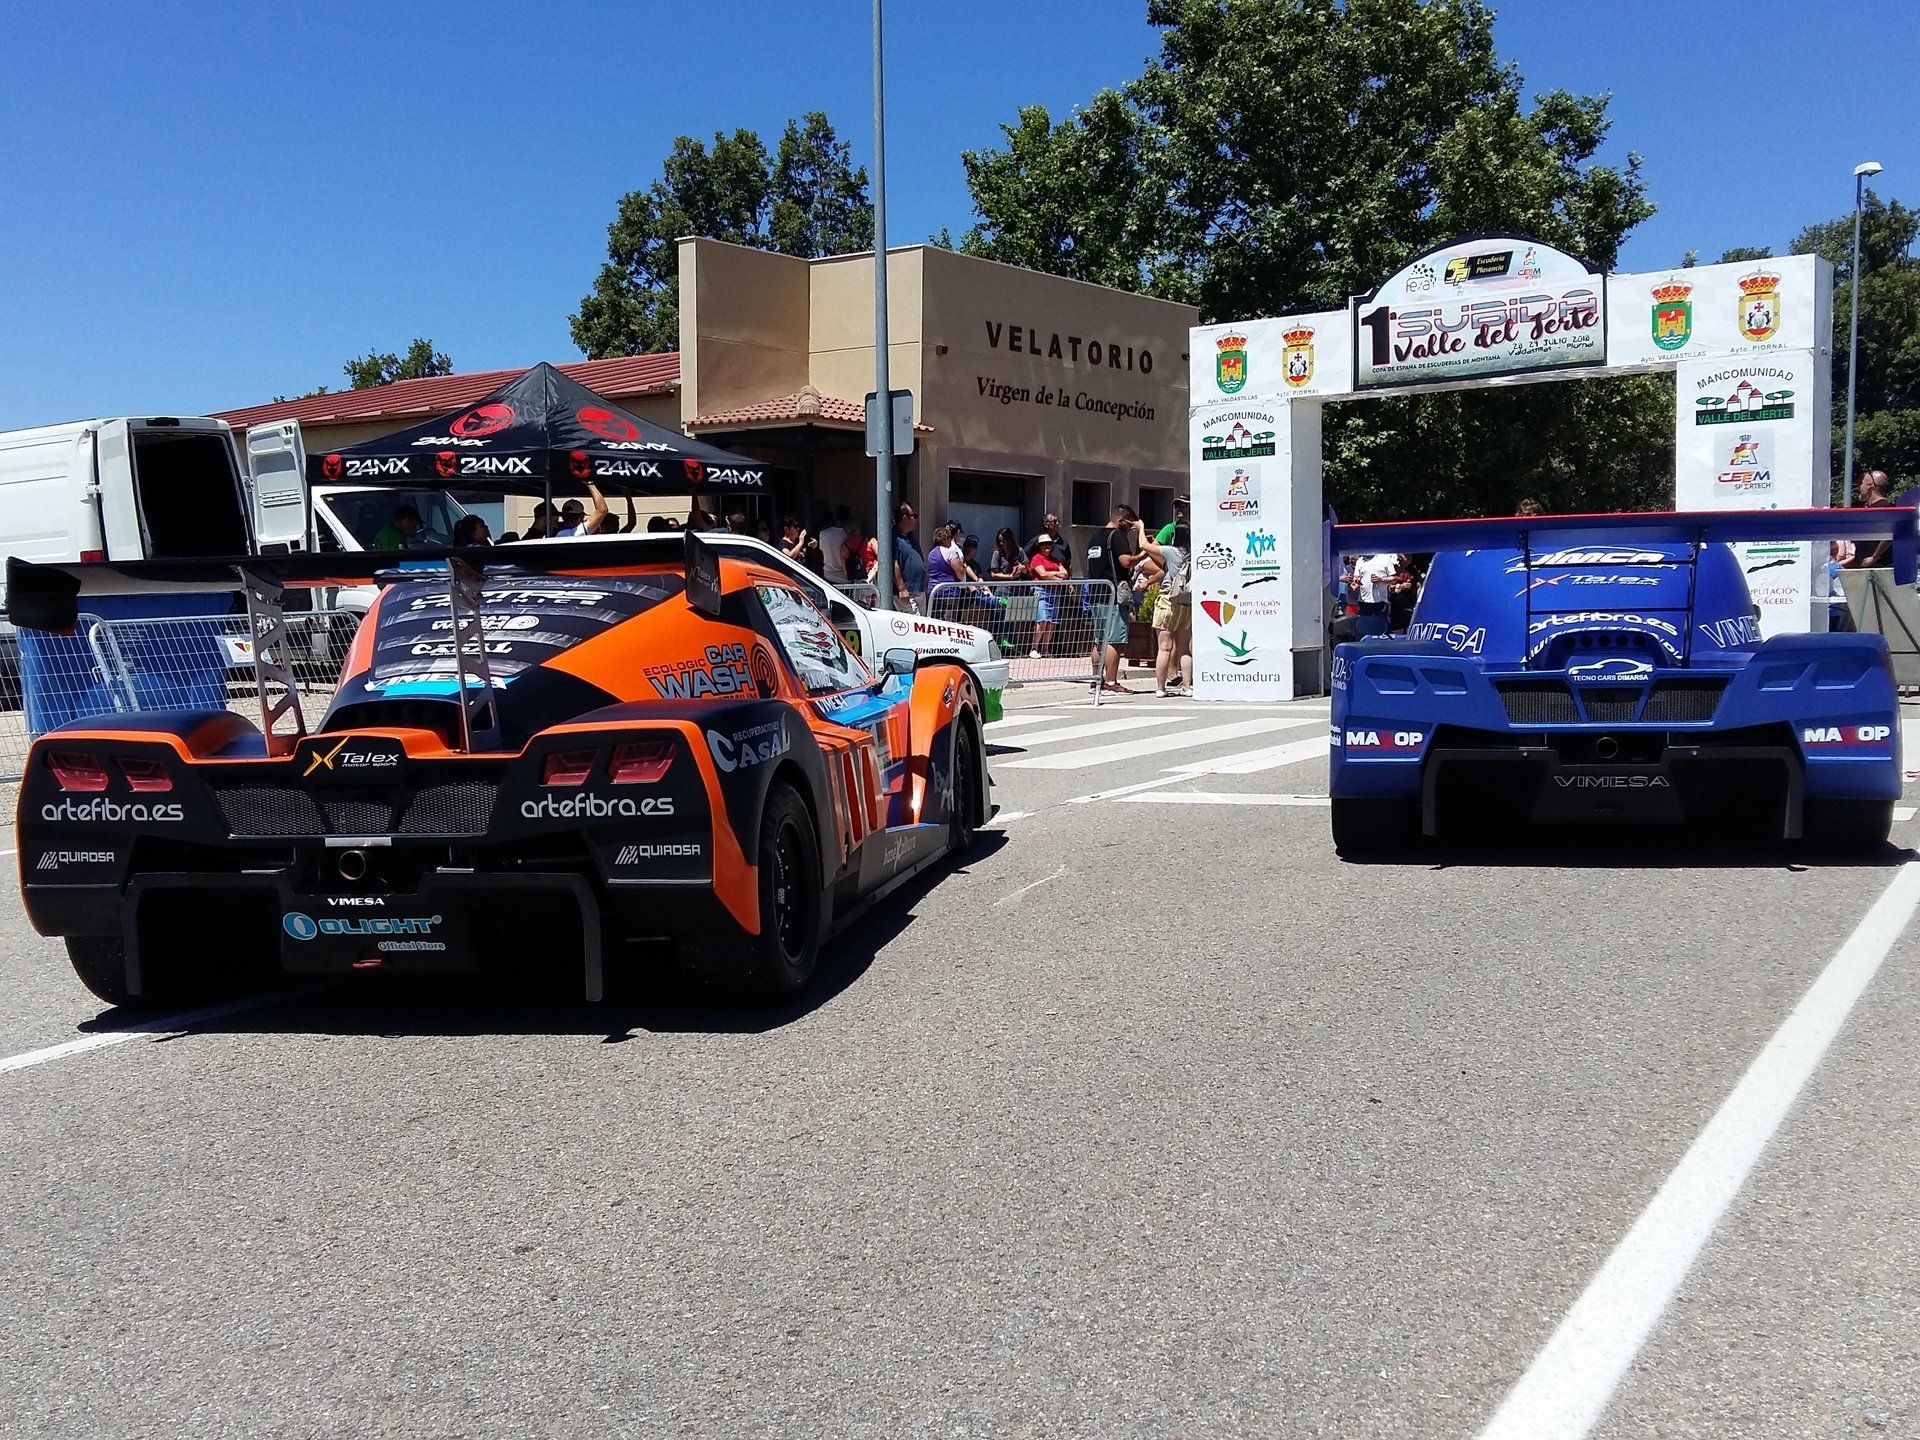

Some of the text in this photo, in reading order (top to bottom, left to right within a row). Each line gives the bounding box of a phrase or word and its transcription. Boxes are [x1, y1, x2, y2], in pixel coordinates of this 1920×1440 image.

[1397, 289, 1598, 338] SUBIDA
[1473, 318, 1519, 349] del
[1530, 305, 1600, 341] Jerte
[985, 320, 1153, 375] VELATORIO
[1543, 336, 1568, 346] JULIO
[1752, 342, 1788, 352] PIORNAL
[1418, 362, 1427, 370] DE
[1462, 357, 1471, 365] DE
[1697, 368, 1794, 389] MANCOMUNIDAD
[976, 375, 1156, 421] Virgen de la Concepción
[1292, 388, 1319, 397] PIORNAL
[1203, 412, 1275, 429] MANCOMUNIDAD
[1698, 407, 1791, 424] VALLE DEL JERTE
[1204, 446, 1272, 459] VALLE DEL JERTE
[345, 457, 411, 476] 24MX
[460, 457, 532, 474] 24MX
[595, 459, 664, 479] 24MX
[706, 466, 763, 487] 24MX
[1718, 471, 1771, 484] CEEM
[1219, 501, 1258, 511] CEEM
[914, 622, 975, 641] MAPFRE
[1529, 612, 1678, 636] artefibra.es
[949, 637, 975, 648] PIORNAL
[706, 644, 746, 665] CAR
[642, 658, 707, 677] ECOLOGIC
[648, 664, 754, 699] WASH
[1201, 671, 1281, 683] Extremadura
[815, 695, 848, 713] VIMESA
[707, 712, 791, 773] CASAL
[341, 752, 399, 764] Talex
[1554, 776, 1670, 787] VIMESA
[41, 798, 184, 821] artefibra.es
[521, 793, 675, 818] artefibra.es
[327, 898, 385, 906] VIMESA
[318, 918, 433, 934] OLIGHT
[378, 942, 446, 951] Official Store
